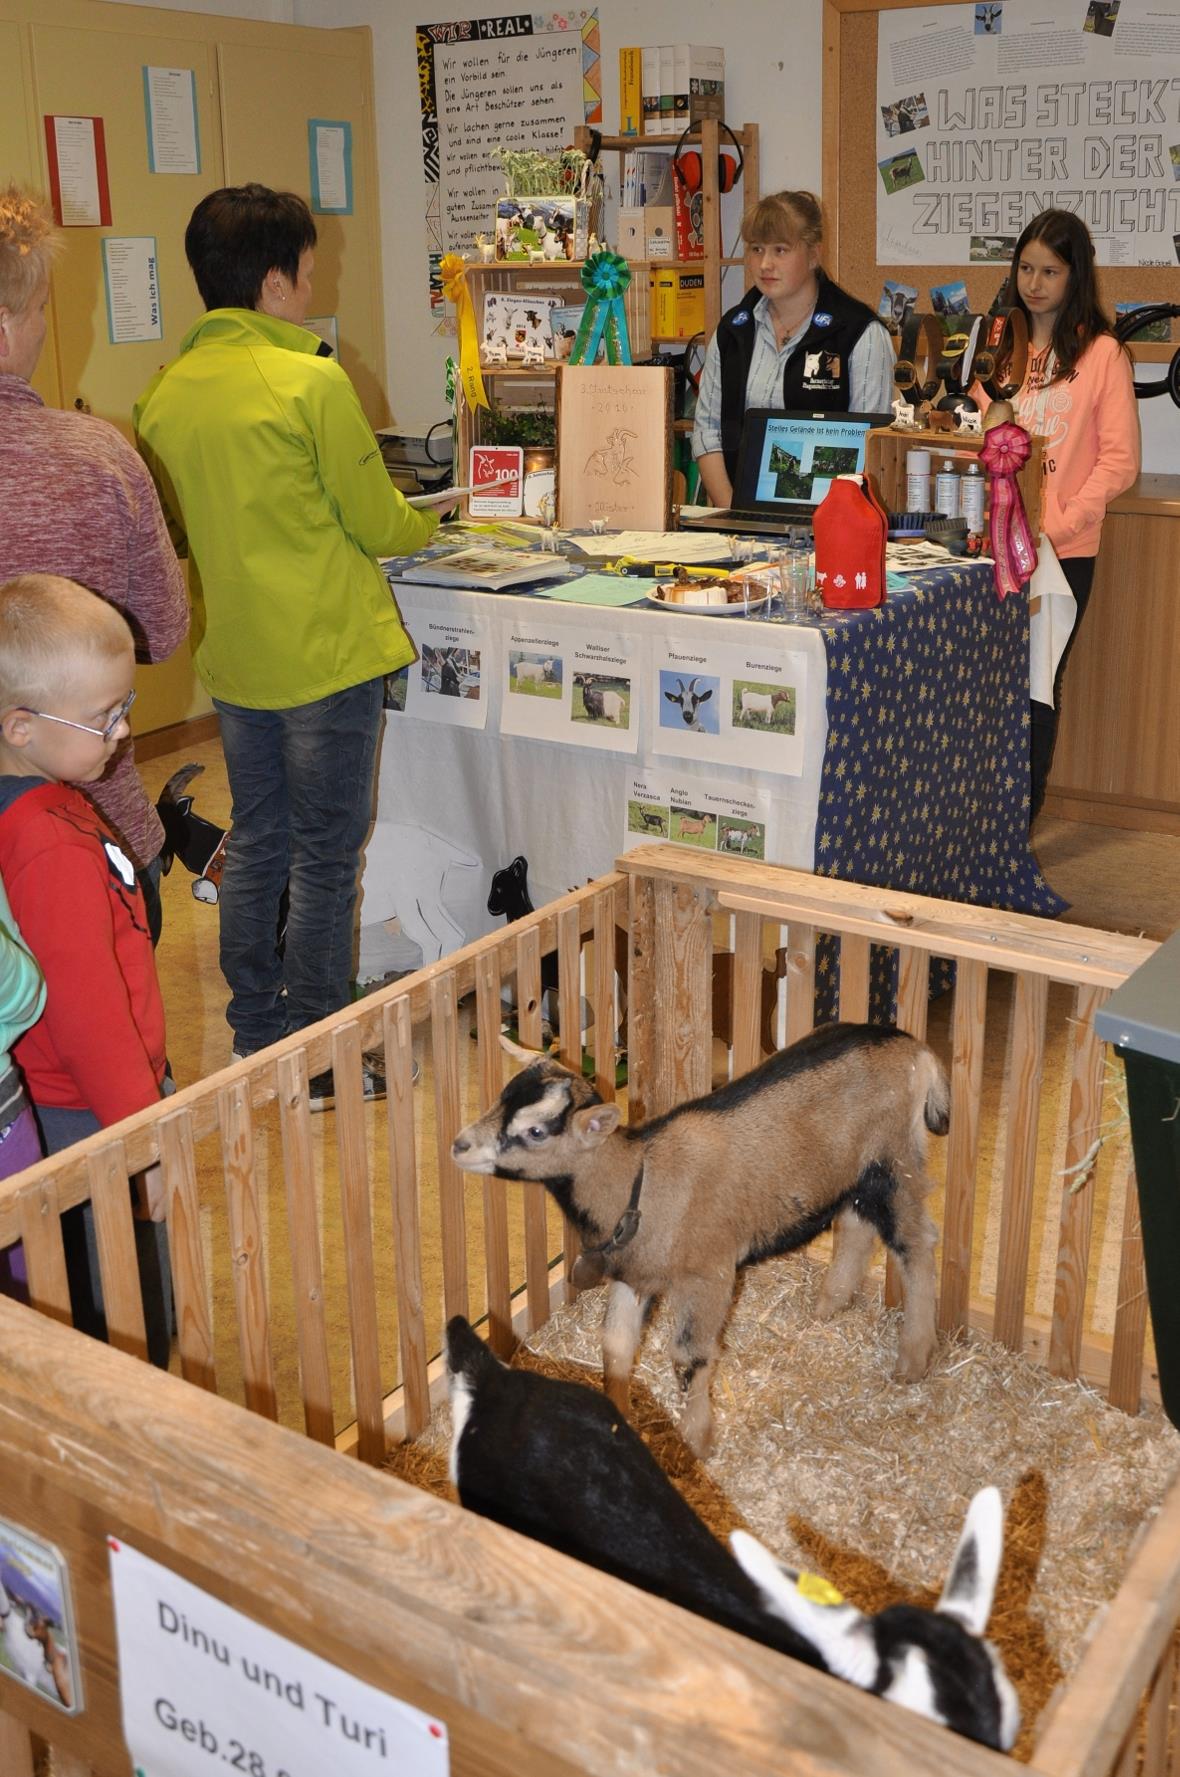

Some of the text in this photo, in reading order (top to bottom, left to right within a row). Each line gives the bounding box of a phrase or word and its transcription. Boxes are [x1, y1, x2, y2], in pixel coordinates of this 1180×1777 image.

[486, 17, 525, 37] REAL
[443, 47, 577, 70] Wir wollen für die Jüngeren
[444, 76, 456, 85] ein
[460, 72, 487, 81] Vorbild
[445, 80, 563, 102] Die Jüngeren sollen uns als
[446, 97, 554, 114] eine Art Beschützer sehen
[938, 85, 1027, 131] WAS
[447, 116, 565, 134] Wir lachen gerne zusammen
[448, 138, 462, 147] und
[466, 136, 481, 144] sind
[506, 132, 525, 142] coole
[926, 134, 1166, 182] HINTER DER
[447, 166, 461, 176] und
[447, 187, 459, 198] Wir
[462, 187, 486, 197] wollen
[446, 203, 466, 215] guten
[451, 214, 489, 224] Aussenseiter
[680, 279, 703, 288] DUDEN
[768, 424, 788, 433] Steiles
[789, 425, 815, 434] Gelände
[825, 428, 839, 436] kein
[510, 635, 559, 647] Appenzellerziege
[586, 643, 610, 652] Walliser
[574, 652, 627, 665] Schwarzhalsziege
[668, 652, 707, 664] Pfauenziege
[745, 661, 782, 673] Burenziege
[633, 781, 647, 790] Nera
[670, 787, 688, 797] Anglo
[670, 797, 692, 806] Nubian
[732, 808, 748, 817] ziege
[158, 1600, 388, 1758] Dinu und Turi
